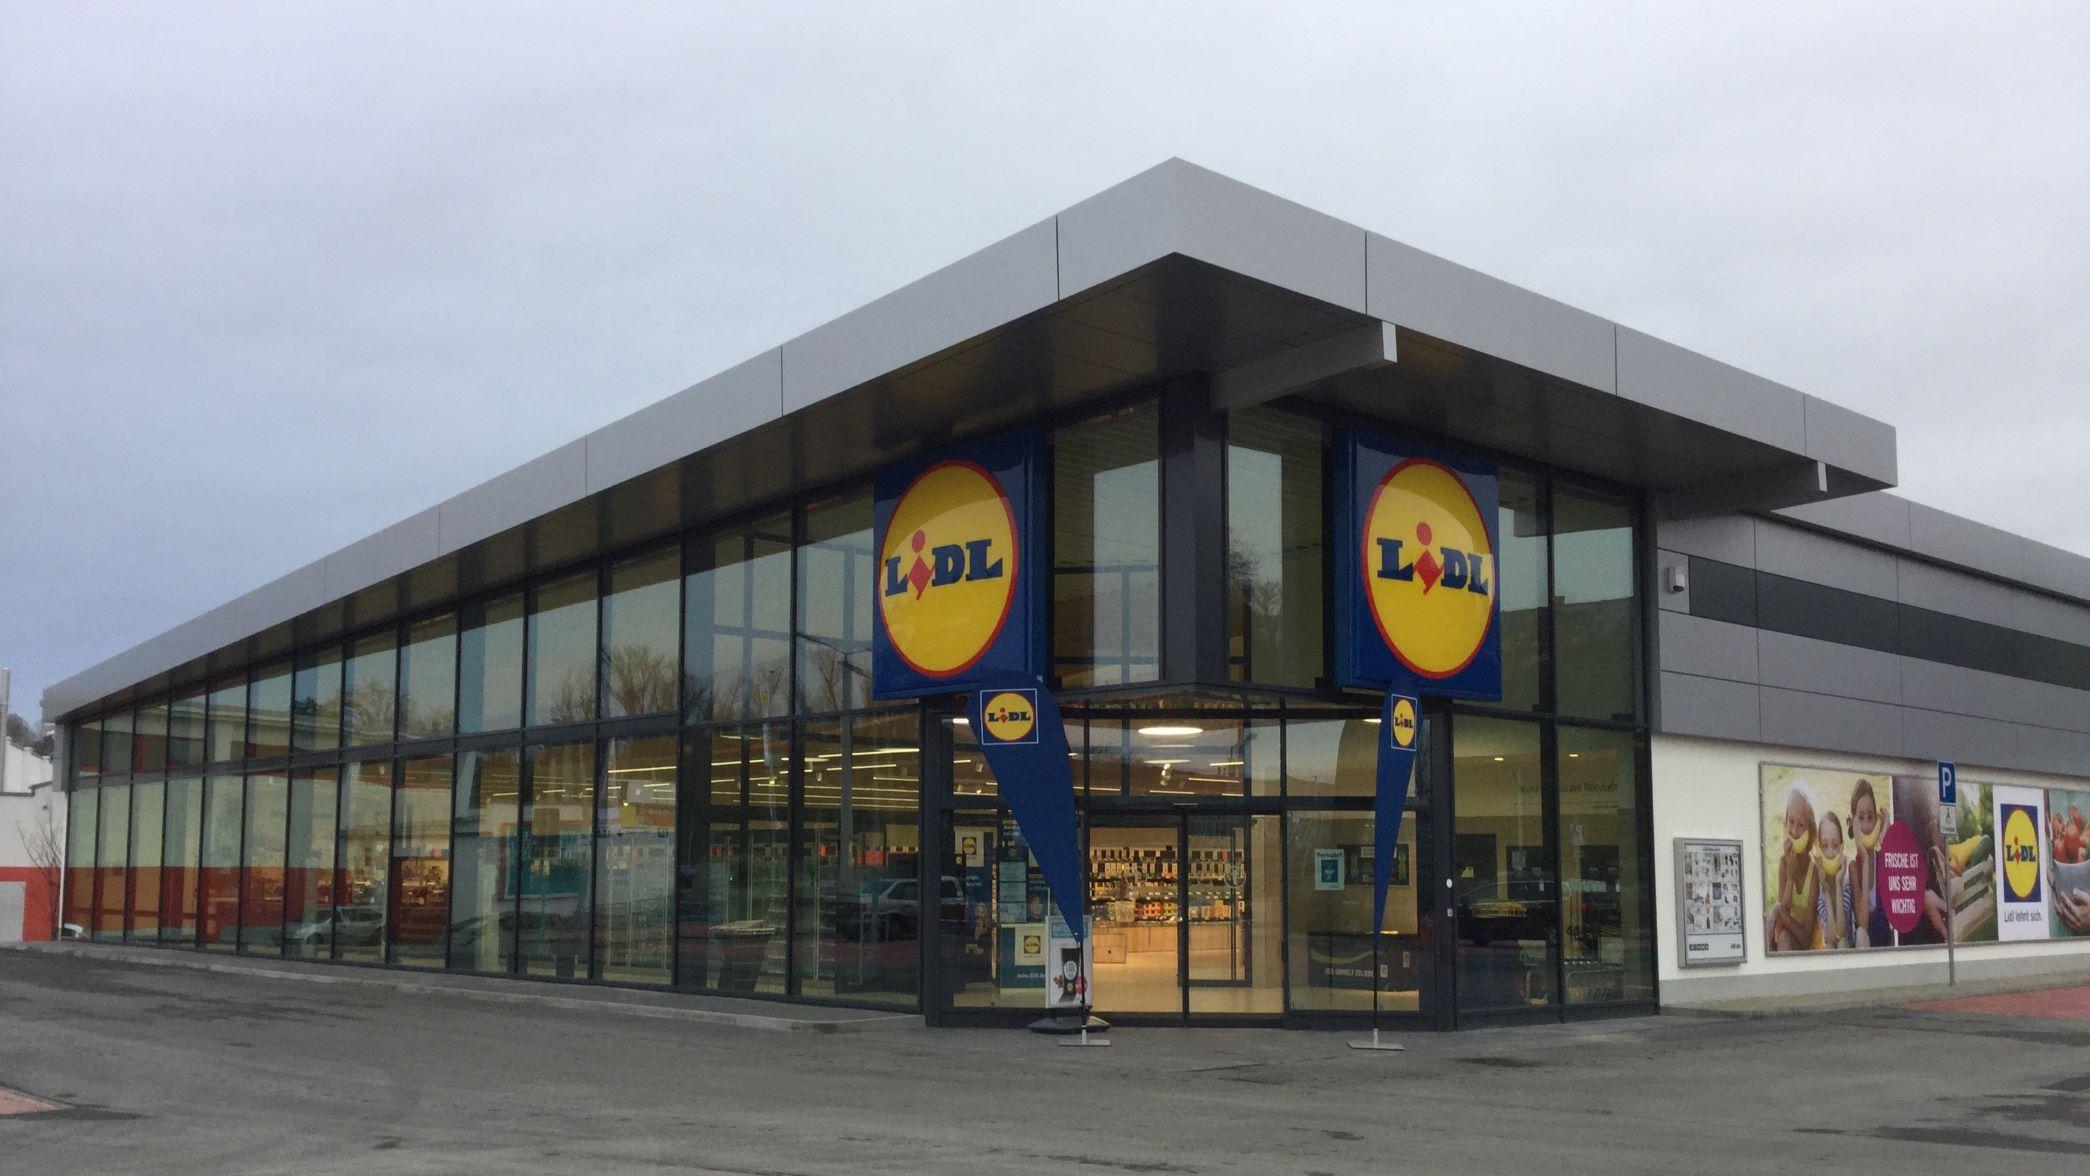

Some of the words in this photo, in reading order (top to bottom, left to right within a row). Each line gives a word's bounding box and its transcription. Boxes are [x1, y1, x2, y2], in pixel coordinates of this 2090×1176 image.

[1942, 766, 1952, 798] P
[1885, 853, 1909, 869] FRISCHE
[1910, 853, 1919, 869] IST
[1888, 876, 1900, 891] UNS
[1902, 876, 1917, 891] SEHR
[1891, 898, 1916, 914] WICHTIG
[2004, 909, 2015, 922] Lidl
